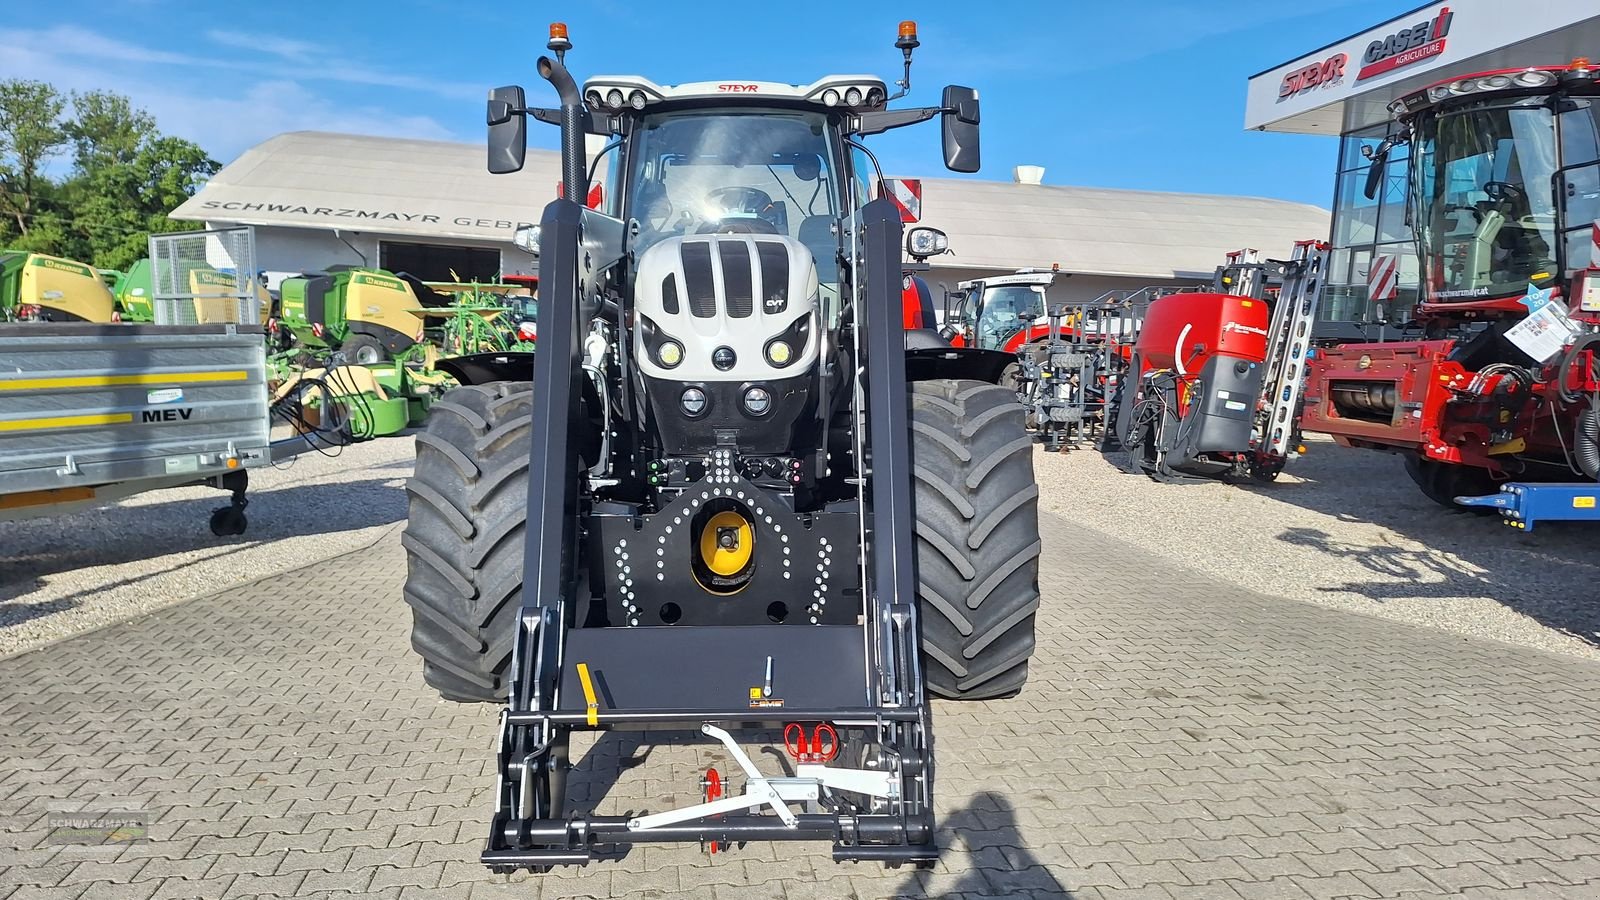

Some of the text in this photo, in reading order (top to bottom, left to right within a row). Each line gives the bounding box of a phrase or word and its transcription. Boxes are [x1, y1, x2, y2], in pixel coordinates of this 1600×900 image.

[1364, 21, 1429, 63] CASE
[1395, 43, 1440, 65] AGRICULTURE
[1279, 53, 1347, 97] STEYR
[718, 84, 758, 93] STEYR
[201, 200, 441, 224] SCHWARZMAYR
[766, 299, 784, 307] CVT
[1528, 291, 1545, 302] TOP
[1532, 299, 1545, 307] 20
[142, 408, 192, 423] MEV
